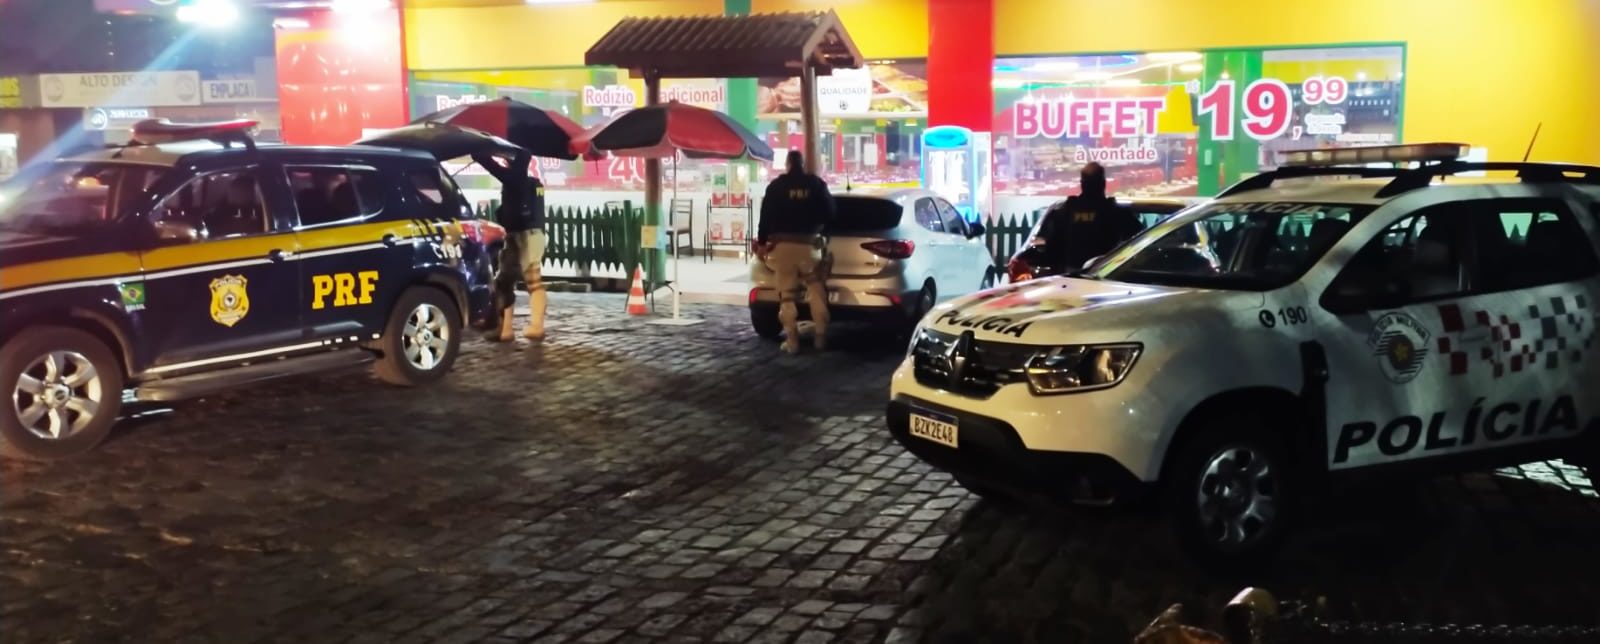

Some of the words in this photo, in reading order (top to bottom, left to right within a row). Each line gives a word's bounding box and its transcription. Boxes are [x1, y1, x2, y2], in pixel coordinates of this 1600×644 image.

[80, 75, 108, 87] ALTO
[112, 75, 158, 87] DESN
[820, 87, 867, 95] QUALIDADE
[1303, 77, 1347, 103] 99
[660, 86, 723, 104] adicional
[1015, 100, 1164, 137] BUFFET
[1091, 146, 1156, 161] vontade
[312, 270, 379, 310] PRF
[1278, 306, 1307, 326] 190
[914, 417, 953, 443] BZK2E48
[1333, 396, 1579, 464] POLÍCIA
